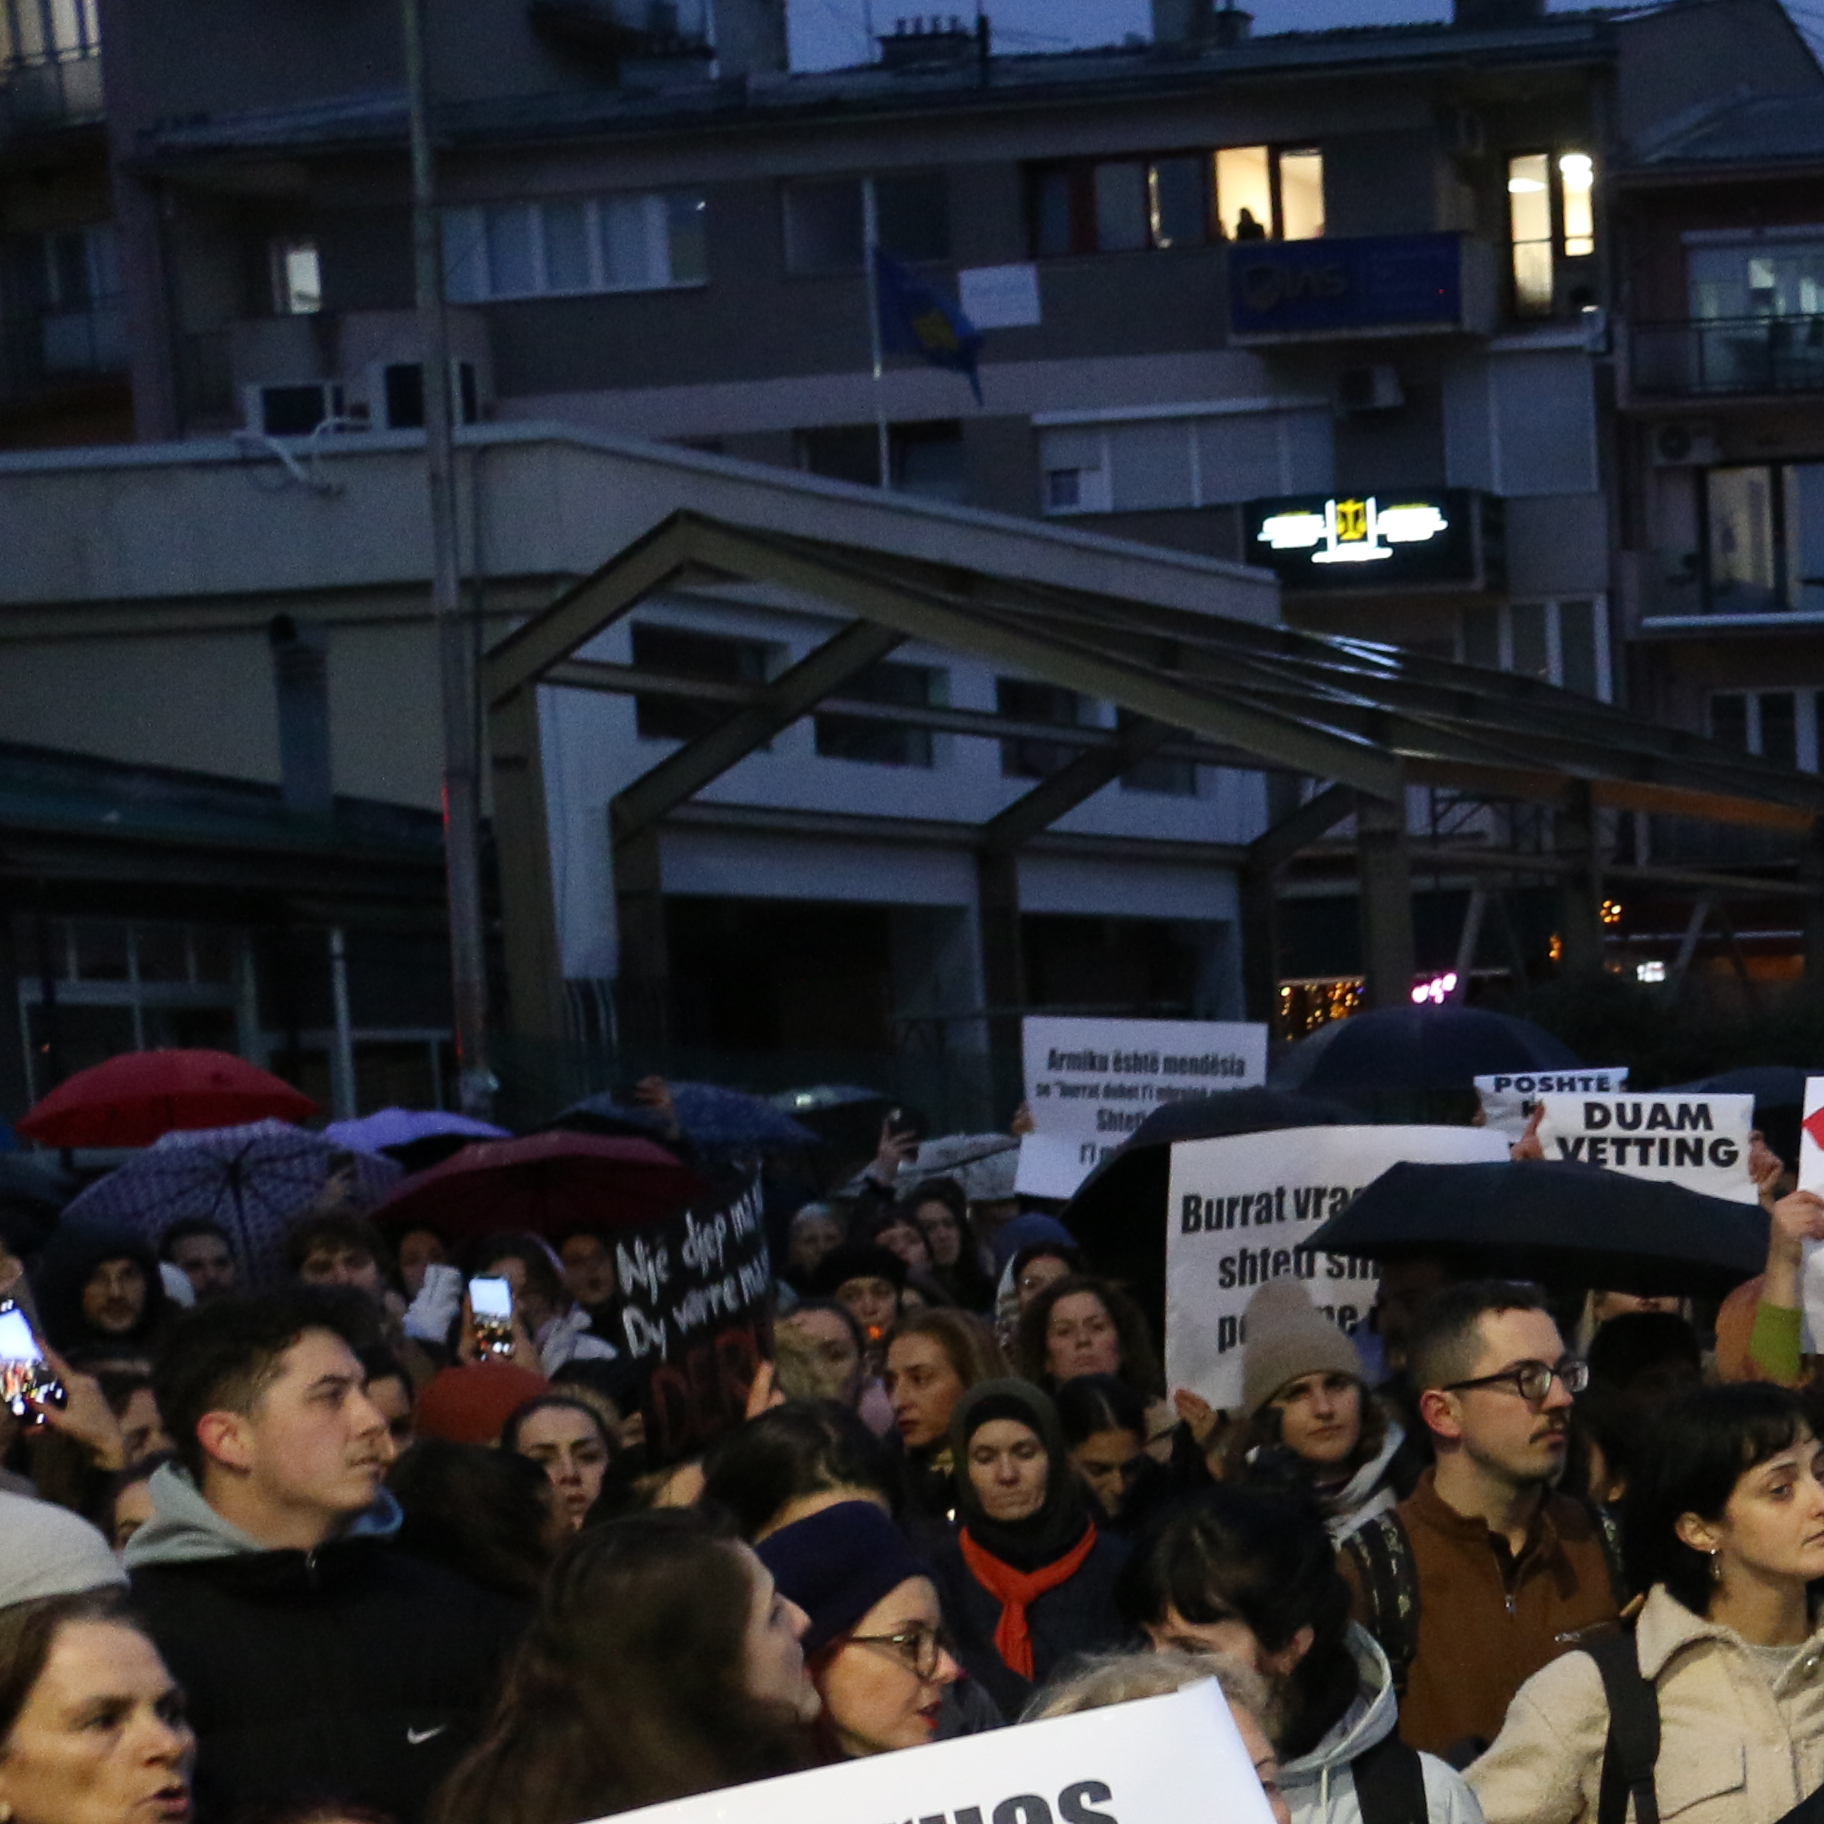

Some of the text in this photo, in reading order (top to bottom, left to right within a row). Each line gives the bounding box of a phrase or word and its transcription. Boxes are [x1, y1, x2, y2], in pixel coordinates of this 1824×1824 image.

[1048, 1048, 1108, 1072] Armiku
[1113, 1050, 1159, 1074] është
[1584, 1102, 1714, 1131] DUAM
[1556, 1137, 1739, 1167] VETTING
[1181, 1186, 1285, 1233] Burrat
